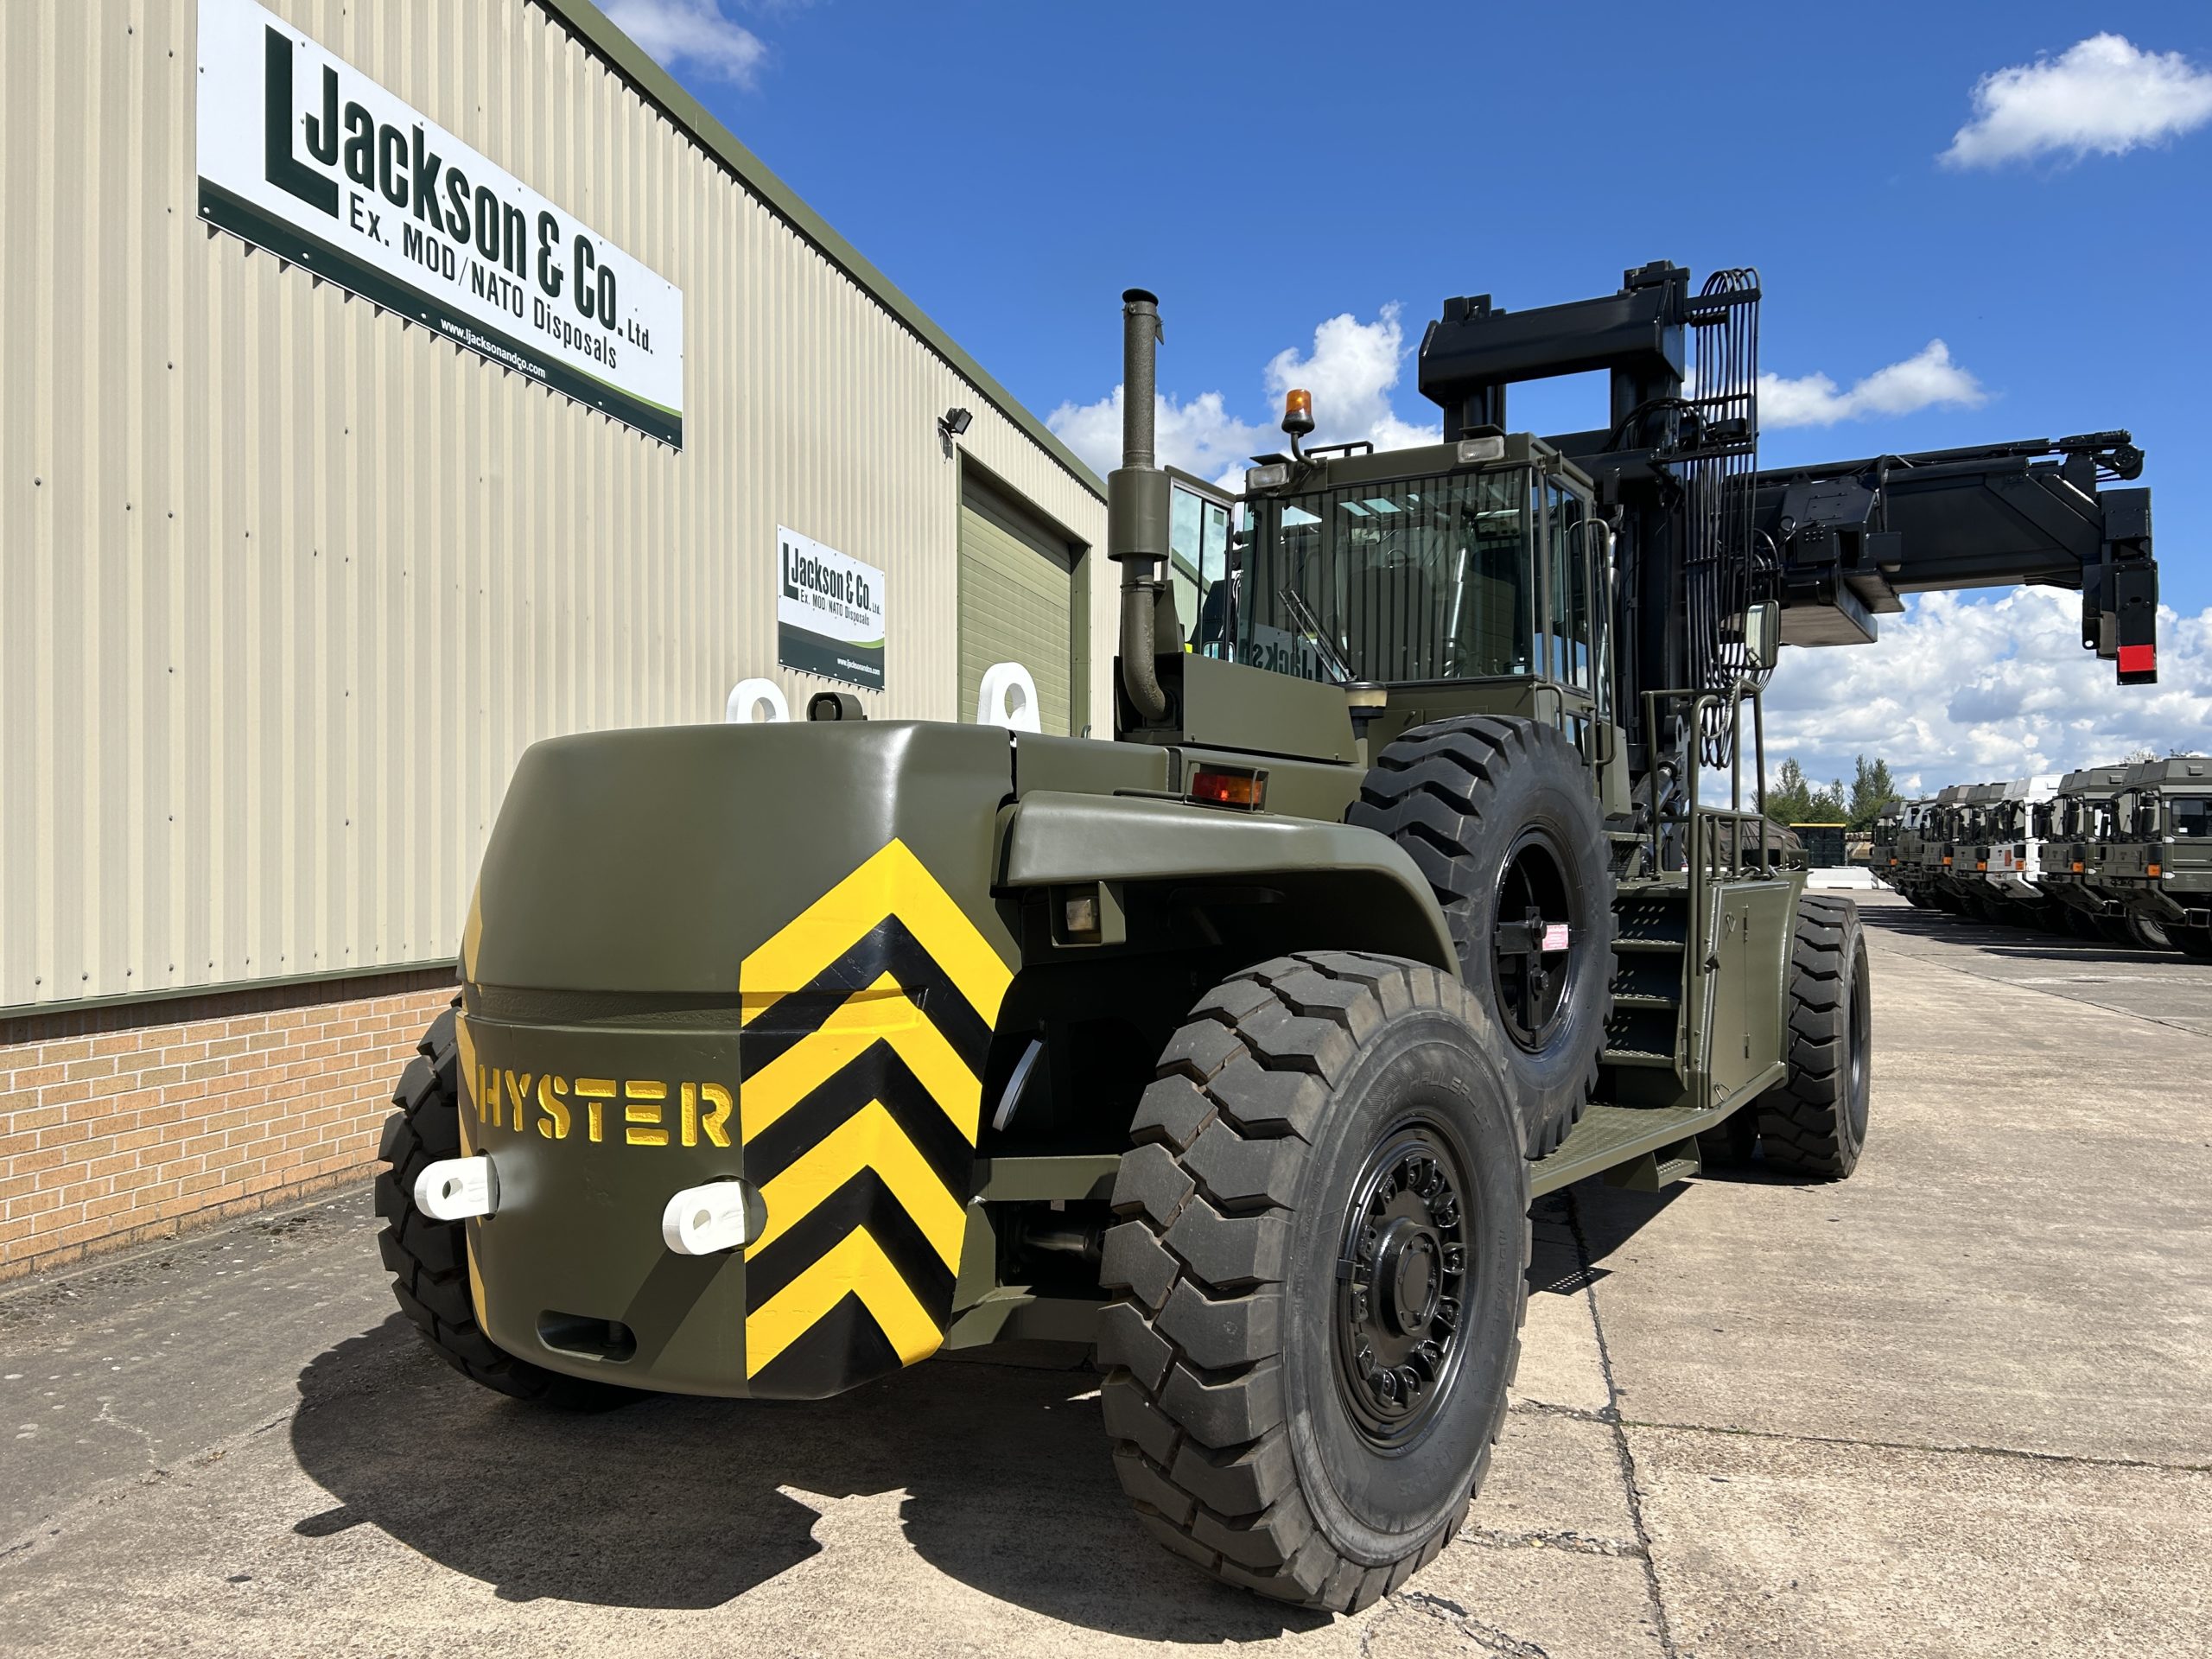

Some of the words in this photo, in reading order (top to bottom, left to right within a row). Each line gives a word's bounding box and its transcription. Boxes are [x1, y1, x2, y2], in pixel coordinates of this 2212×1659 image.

[350, 191, 390, 246] Ex.
[534, 296, 617, 370] Disposals
[537, 211, 564, 299] &
[574, 234, 624, 337] Co.
[628, 317, 653, 355] Ltd.
[801, 589, 810, 605] Ex.
[845, 606, 870, 626] Disposals
[846, 570, 855, 604] &
[856, 575, 872, 612] Co.
[479, 1065, 733, 1147] HYSTER
